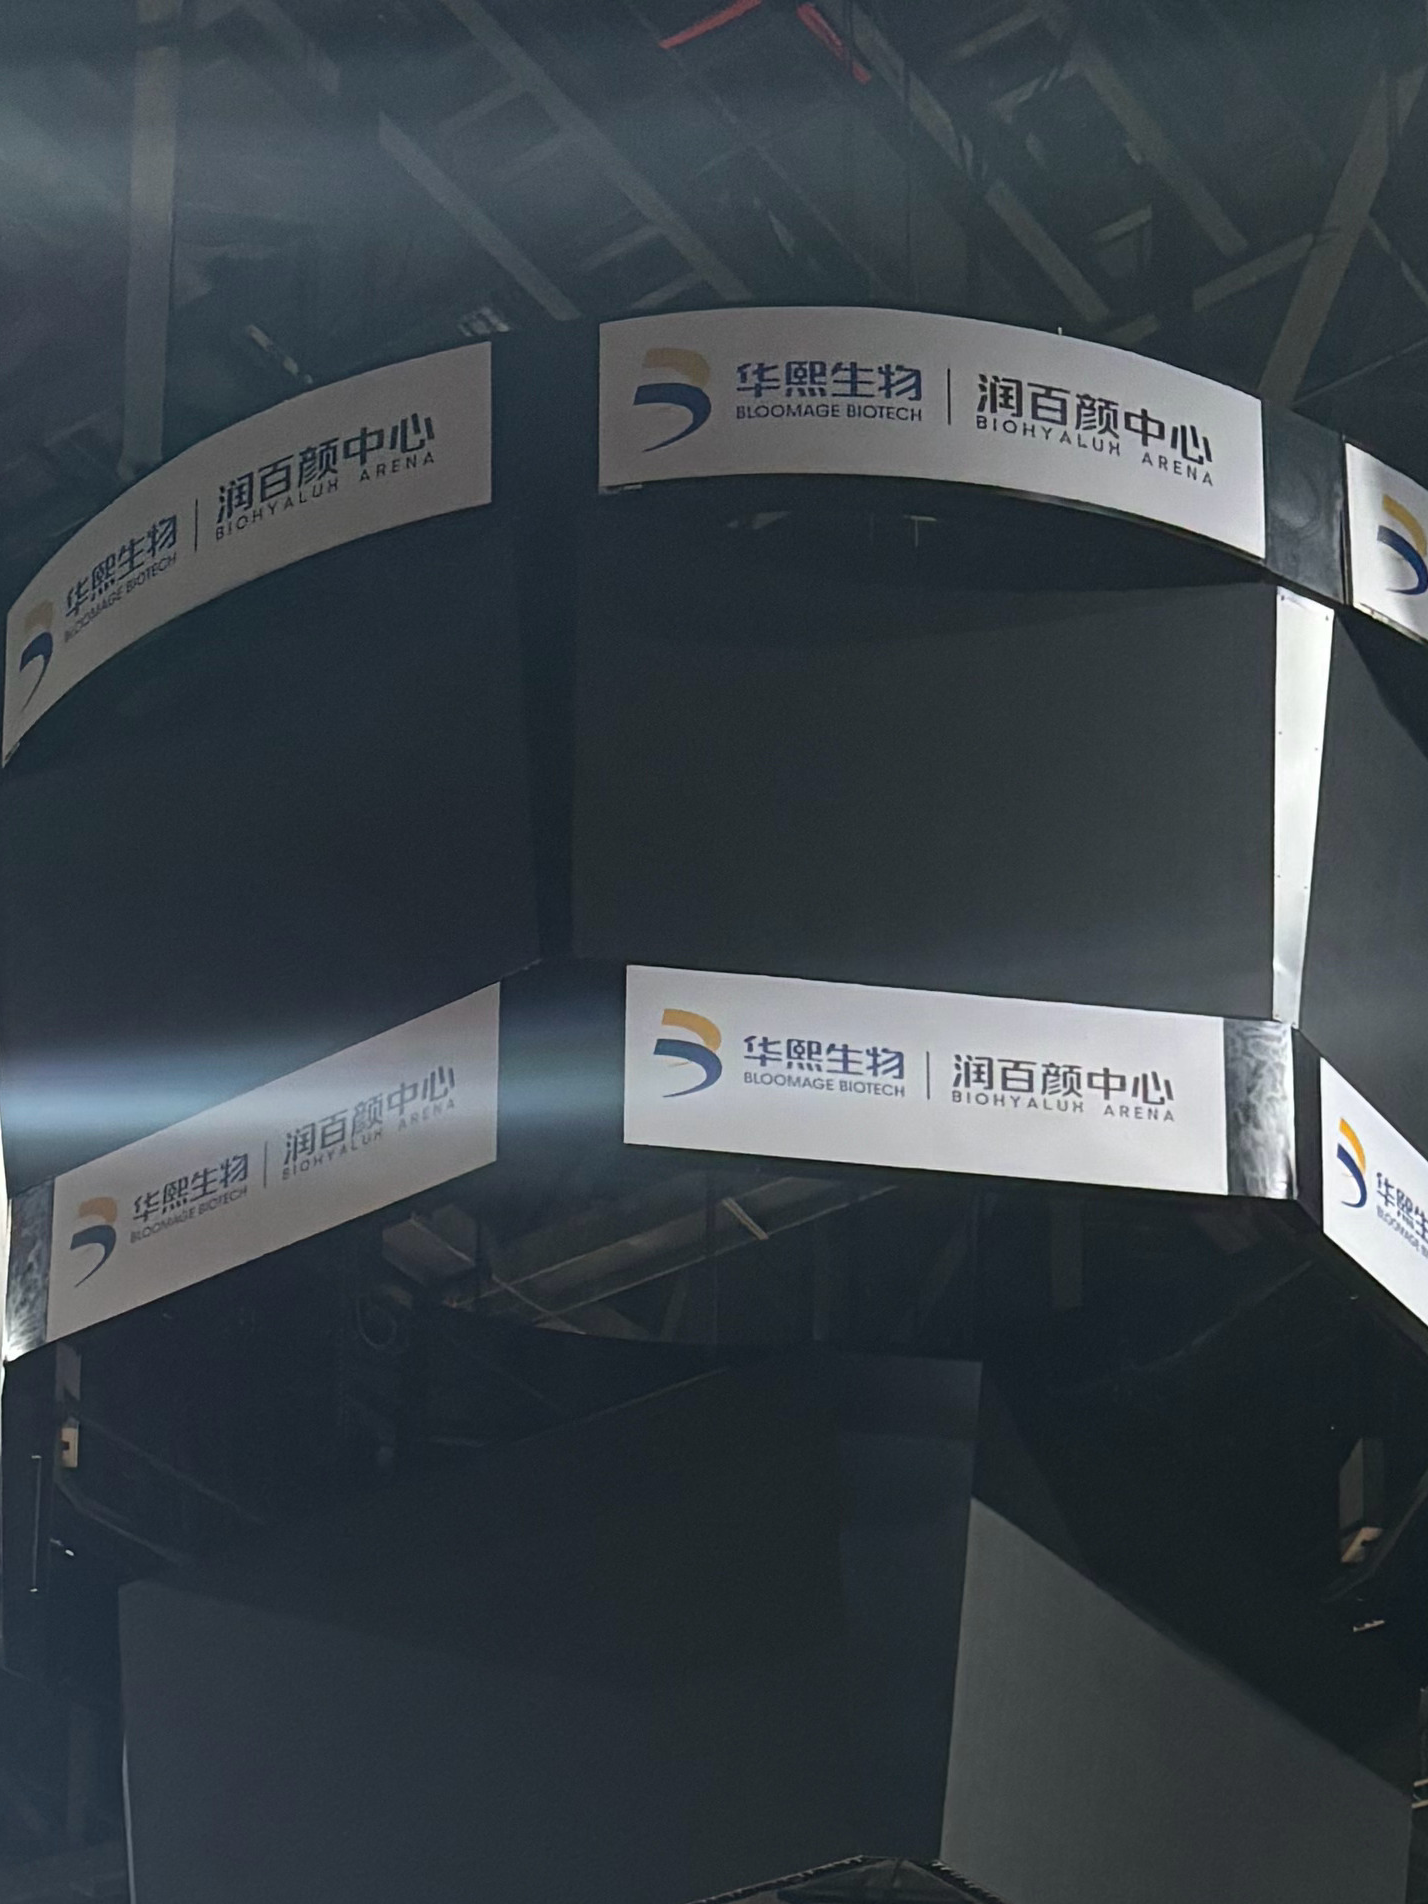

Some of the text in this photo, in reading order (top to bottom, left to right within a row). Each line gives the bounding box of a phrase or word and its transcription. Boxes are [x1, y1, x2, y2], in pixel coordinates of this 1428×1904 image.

[736, 360, 923, 401] 华熙生物
[736, 402, 923, 422] BLOOMAGE BIOTECH
[976, 372, 1213, 465] 润百颜中心
[217, 412, 435, 525] 润百颜中心
[1141, 451, 1215, 487] ARENA
[64, 513, 178, 617] 华熙生物
[742, 1034, 905, 1080] 华熙生物
[953, 1053, 1175, 1106] 润百颜中心
[743, 1071, 905, 1098] BLOOMAGE BIOTECH
[283, 1064, 455, 1166] 润百颜中心
[1103, 1105, 1176, 1123] ARENA
[131, 1154, 248, 1224] 华熙生物
